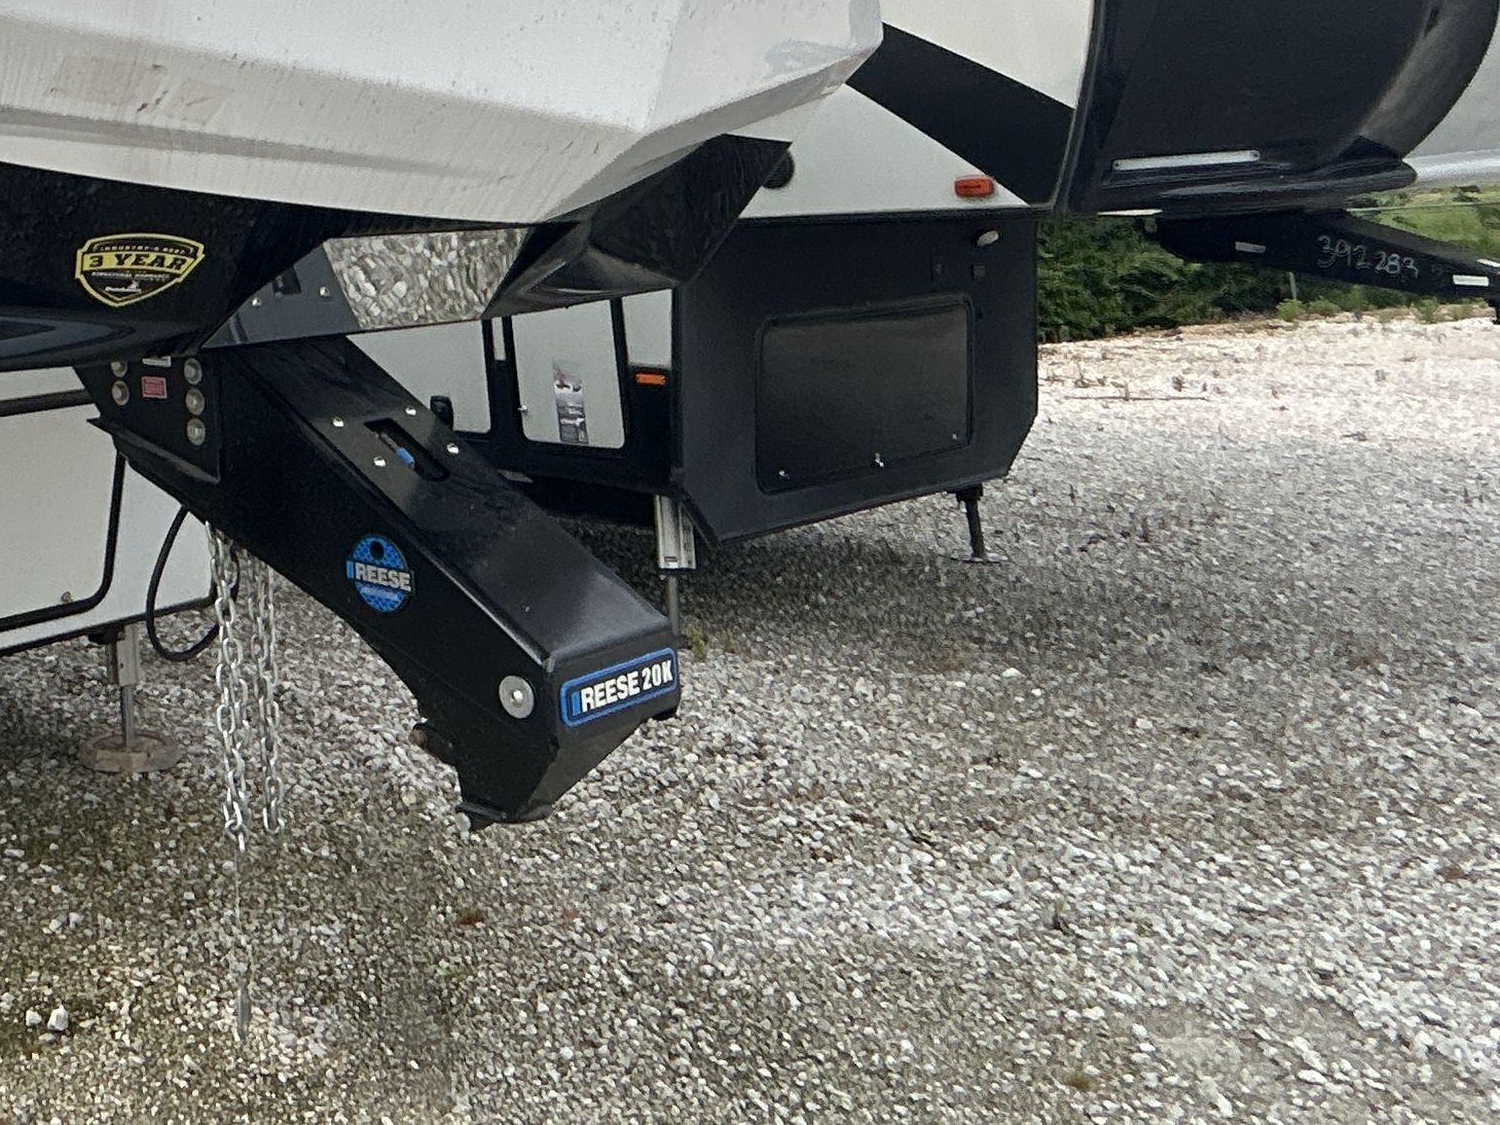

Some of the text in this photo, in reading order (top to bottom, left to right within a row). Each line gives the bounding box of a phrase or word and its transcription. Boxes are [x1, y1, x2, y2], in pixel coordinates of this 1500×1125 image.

[89, 253, 188, 271] 3 YEAR
[355, 562, 412, 592] REESE
[580, 660, 673, 713] REESE 20K
